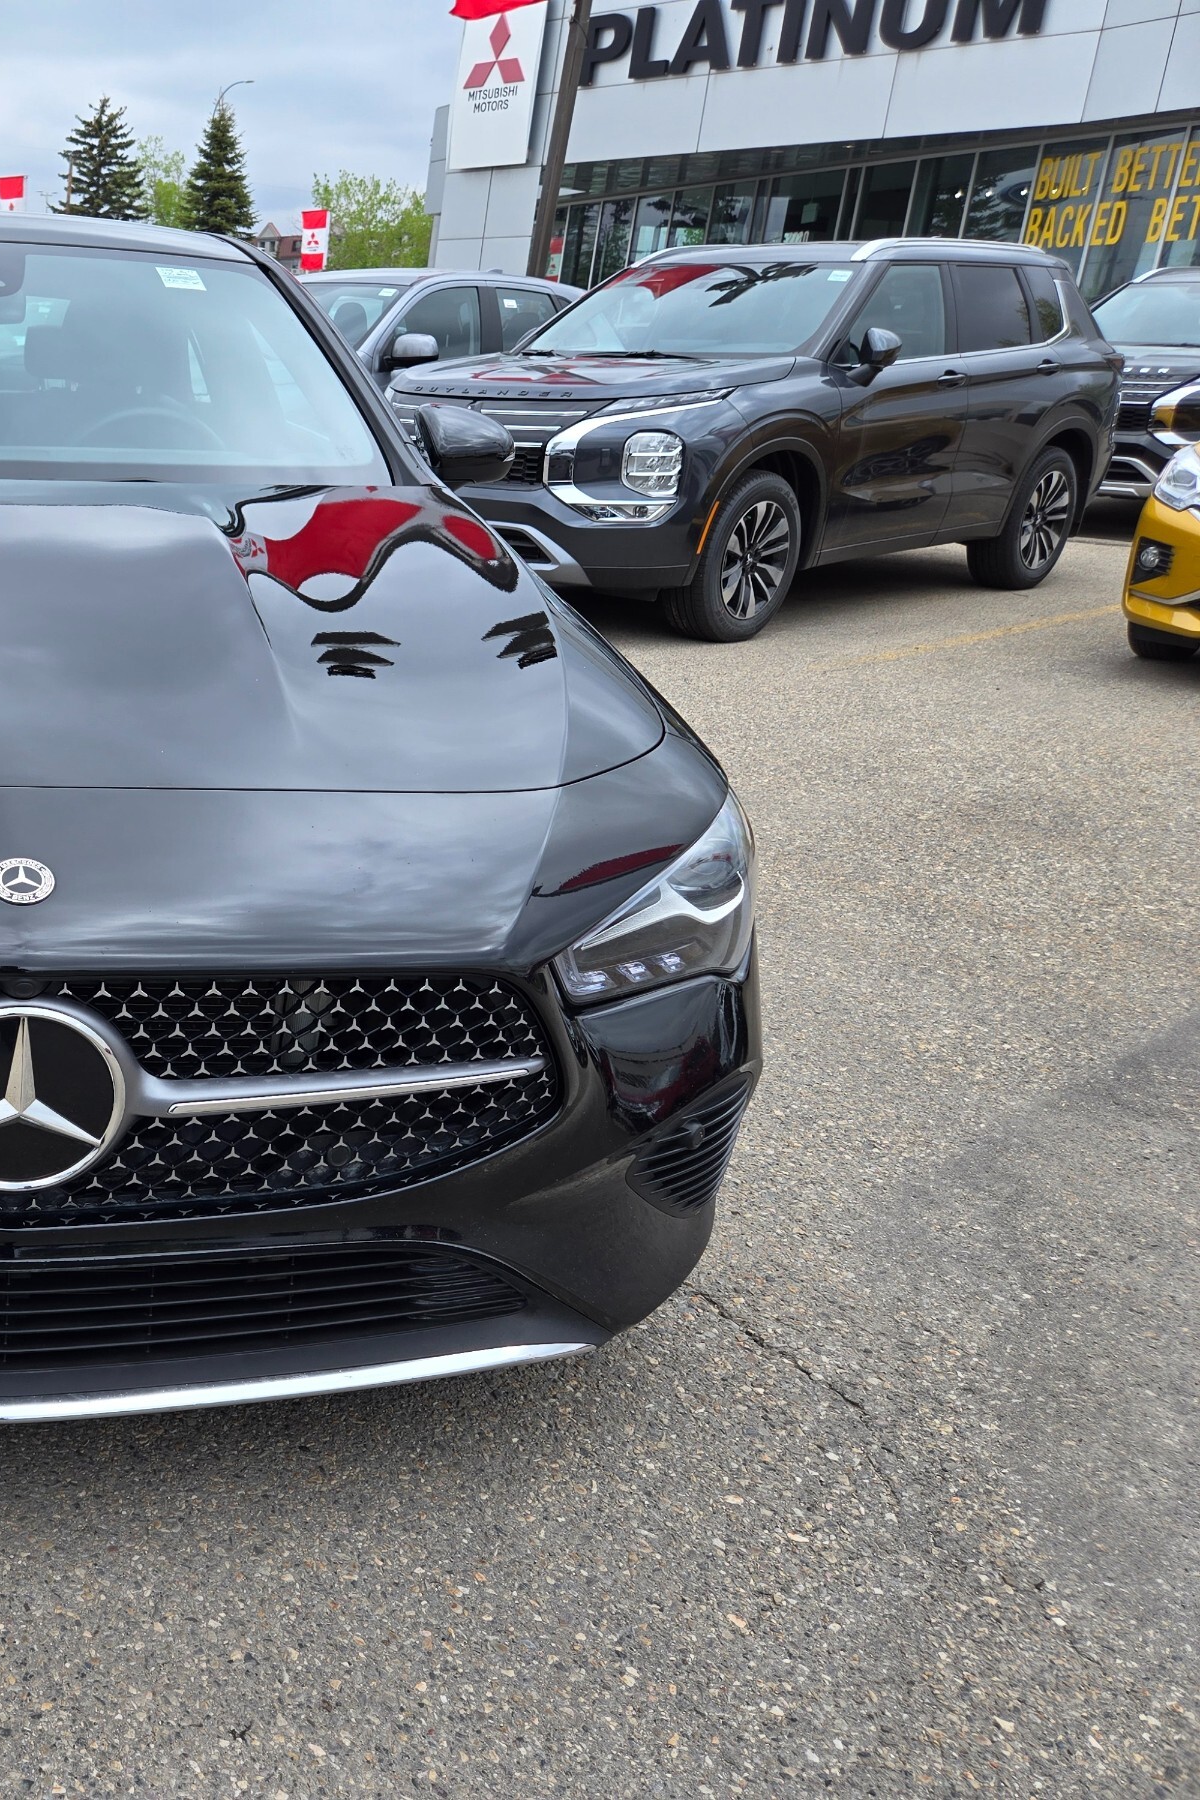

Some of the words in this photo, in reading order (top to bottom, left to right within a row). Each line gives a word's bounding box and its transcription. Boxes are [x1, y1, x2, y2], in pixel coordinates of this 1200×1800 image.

[578, 0, 1047, 87] PLATINUM
[468, 85, 518, 102] MITSUBISHI
[473, 99, 509, 113] MOTORS
[1033, 152, 1103, 201] BUILT
[1111, 141, 1200, 193] BETTE
[1024, 201, 1129, 249] BACKED
[414, 386, 573, 398] OUTLANDER
